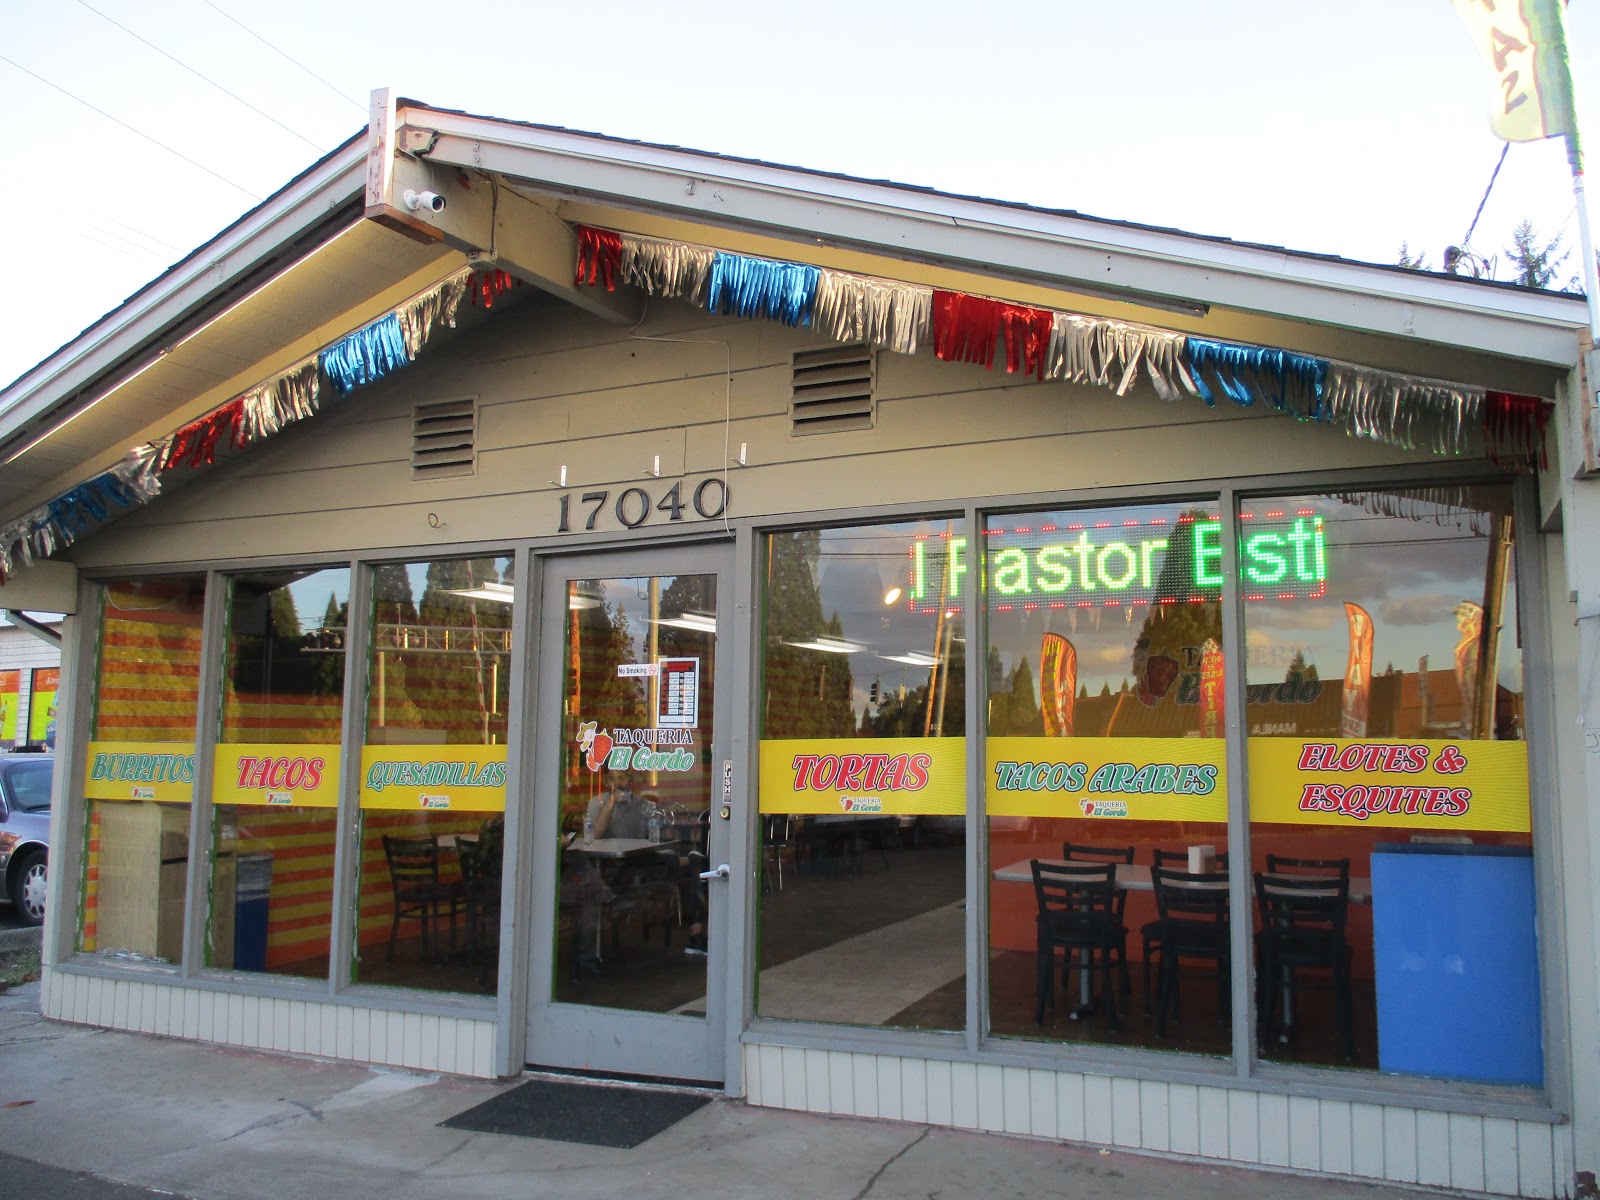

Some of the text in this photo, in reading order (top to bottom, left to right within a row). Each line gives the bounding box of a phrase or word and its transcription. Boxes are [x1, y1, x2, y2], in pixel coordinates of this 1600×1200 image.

[557, 478, 730, 533] 17040
[618, 667, 626, 675] No
[614, 728, 693, 746] TAQUERIA
[91, 752, 196, 783] BURRITOS
[237, 756, 325, 790] TACOS
[608, 747, 694, 771] El Gordo
[792, 753, 932, 791] TORTAS
[1298, 743, 1467, 774] ELOTES &
[366, 761, 507, 792] QUESADILLAS
[724, 764, 732, 793] PUSH
[995, 760, 1218, 795] TACOS ARABES
[852, 804, 881, 812] El Gordo
[1093, 808, 1127, 817] El Gordo
[1094, 801, 1127, 809] TAQUERIA
[1298, 784, 1472, 820] ESQUITES
